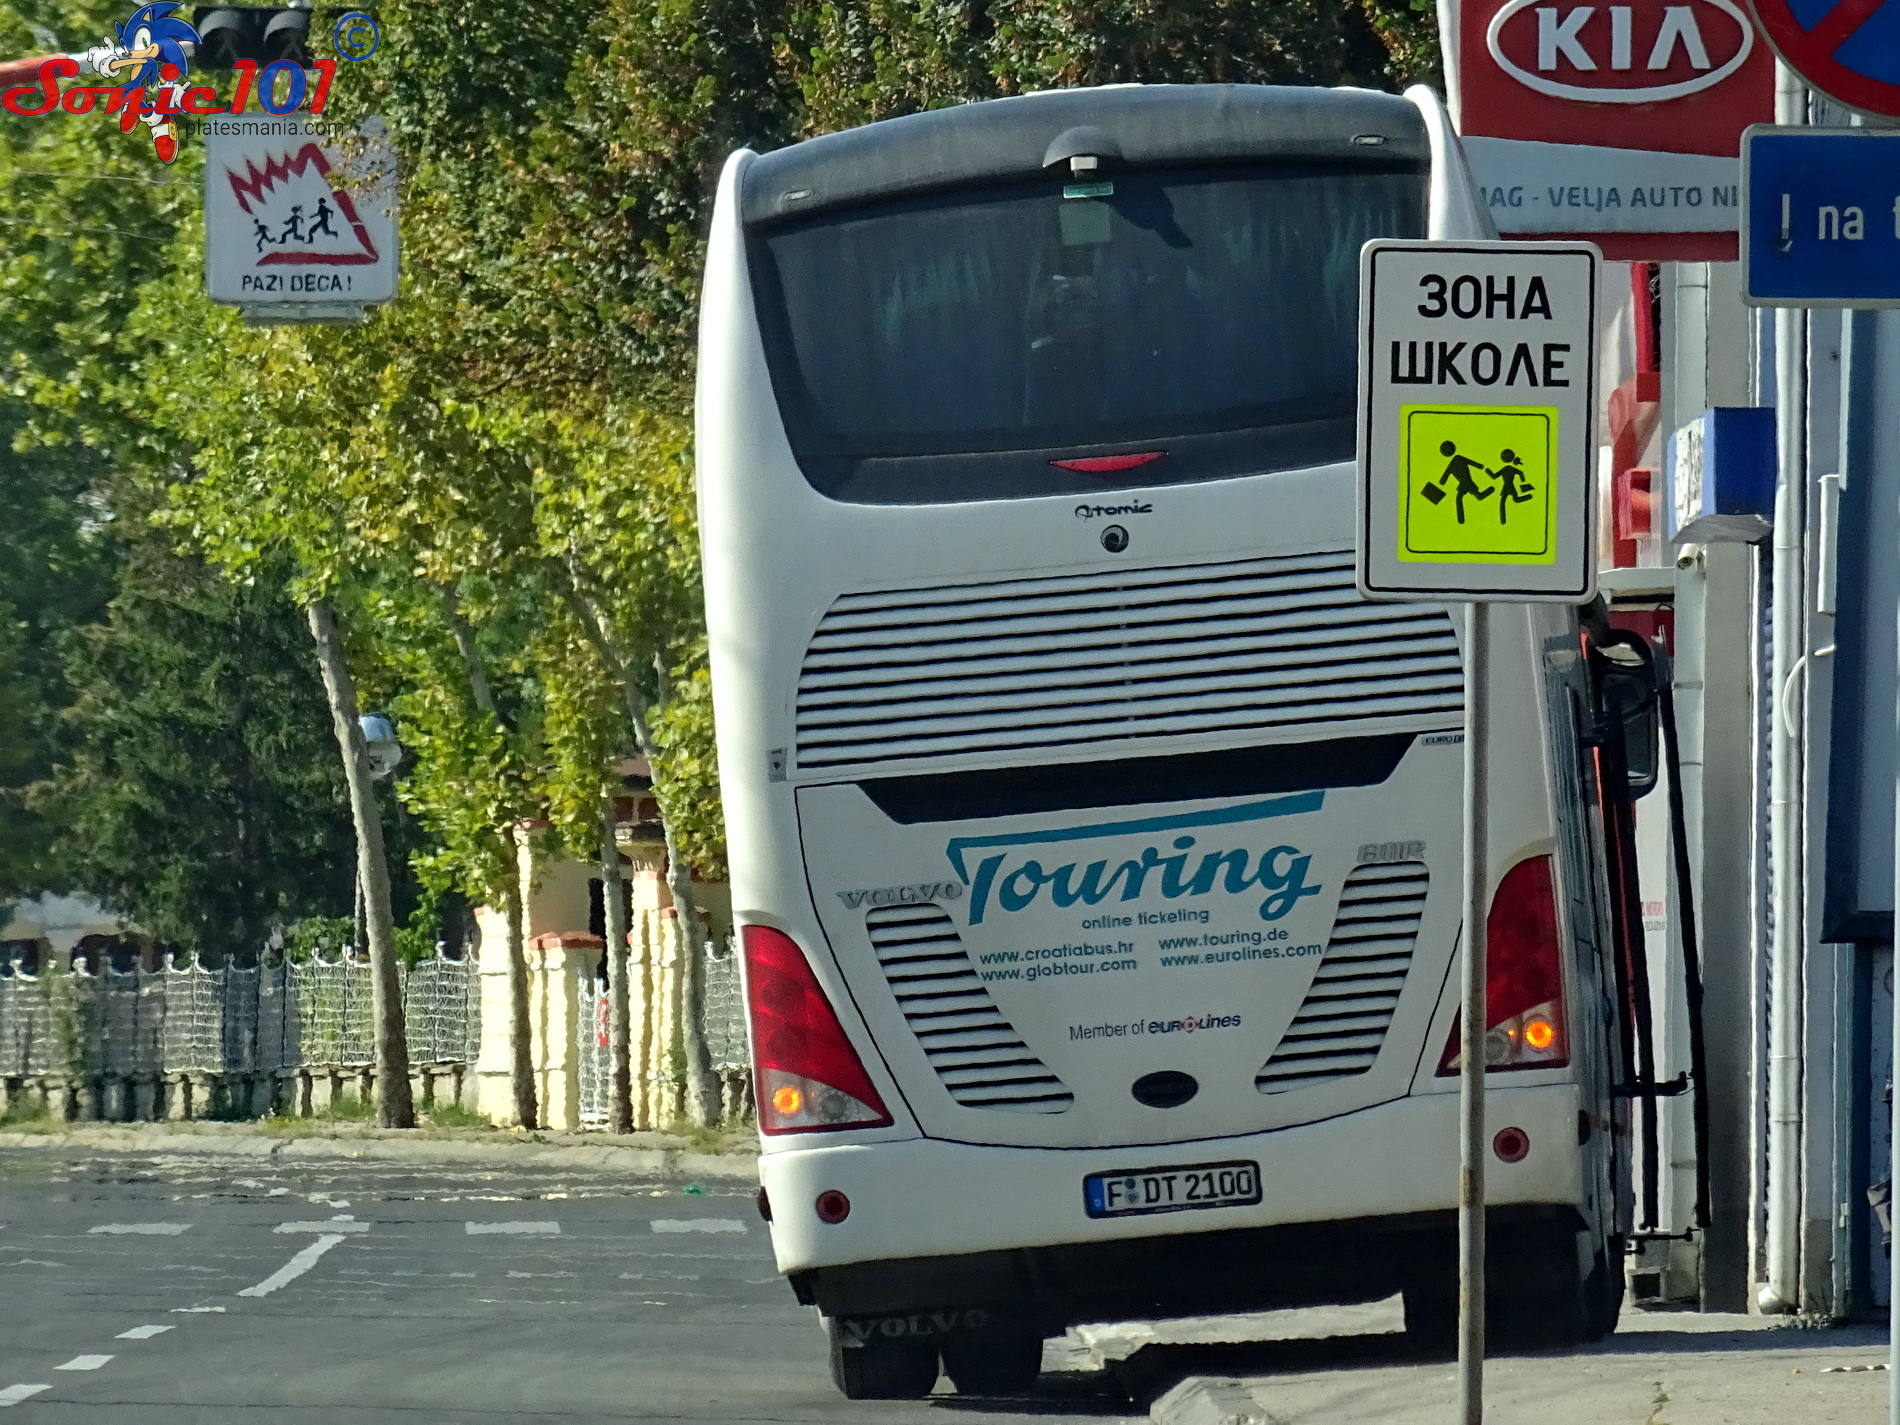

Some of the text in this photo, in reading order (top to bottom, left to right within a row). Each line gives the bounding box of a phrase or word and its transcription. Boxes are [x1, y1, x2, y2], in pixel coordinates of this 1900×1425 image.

[1536, 5, 1711, 71] KIA
[1548, 186, 1622, 212] VELJA
[1630, 186, 1702, 208] AUTO
[1712, 185, 1738, 208] NI
[1818, 205, 1865, 240] na
[242, 274, 284, 292] PAZI
[1417, 274, 1553, 320] ЗОНА
[1390, 341, 1571, 387] ШКОЛЕ
[946, 790, 1325, 926] Touring
[835, 880, 963, 909] VOLVO
[1082, 908, 1210, 930] online ticketing
[979, 940, 1135, 965] www.croatiabus.hr
[1158, 927, 1289, 951] www.touring.de
[1159, 941, 1322, 968] www.eurolines.com
[979, 957, 1138, 982] www.globtour.com
[1069, 1021, 1128, 1041] Member
[1131, 1019, 1146, 1036] of
[1106, 1169, 1254, 1207] F DT 2100
[843, 1309, 990, 1340] VOLVO
